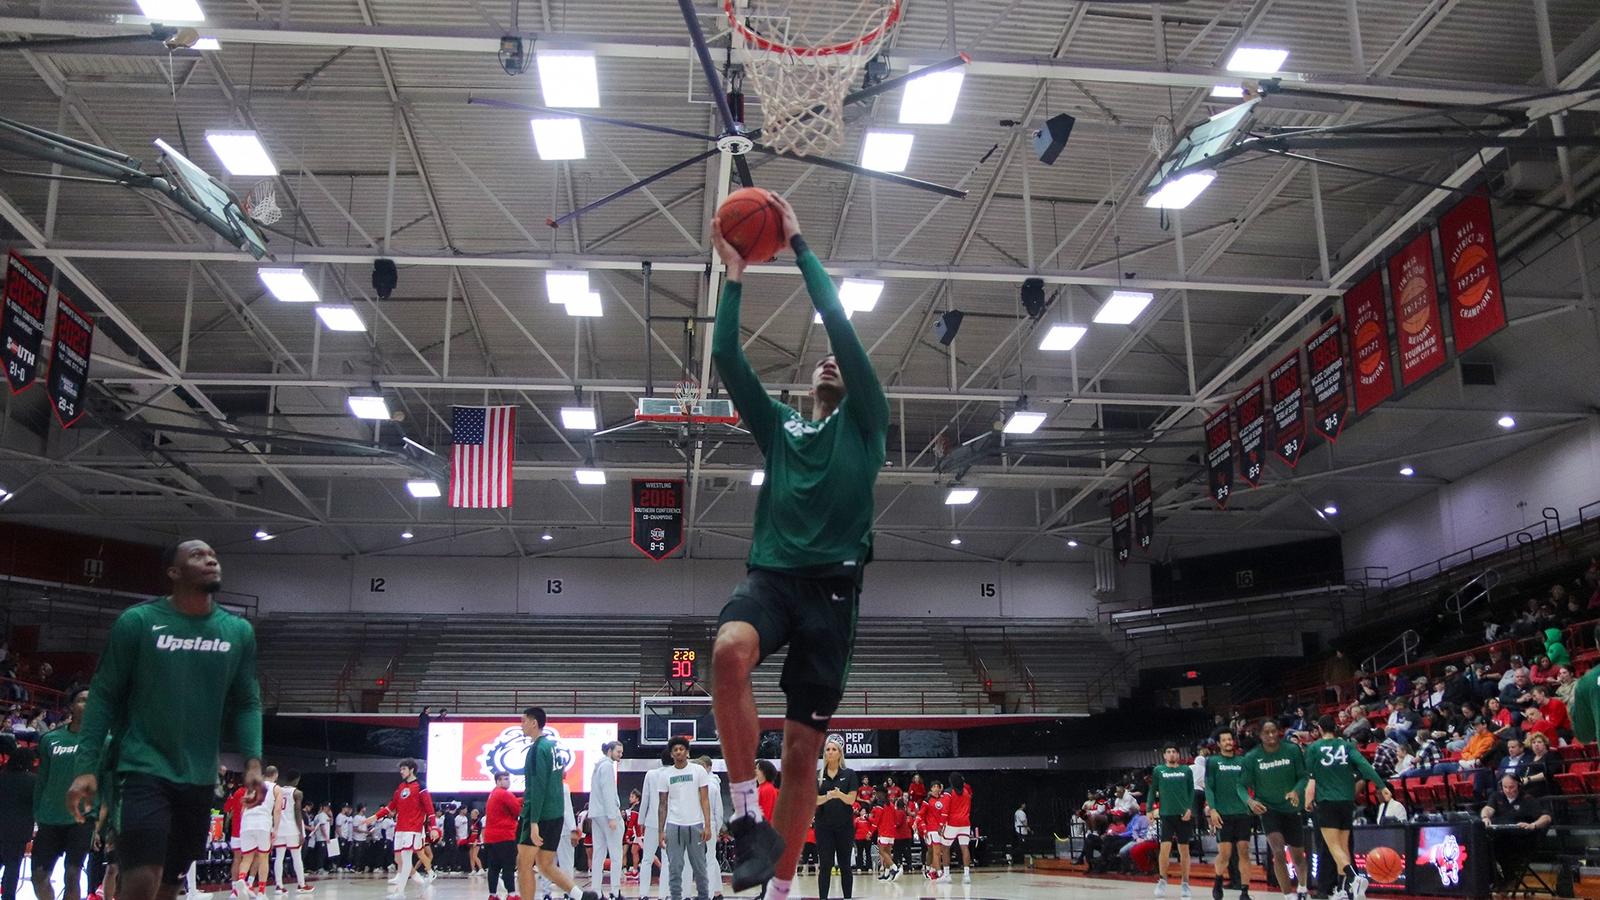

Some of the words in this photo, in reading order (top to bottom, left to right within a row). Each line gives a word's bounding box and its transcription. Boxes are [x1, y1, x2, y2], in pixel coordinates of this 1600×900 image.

[1457, 265, 1486, 290] 1973-74
[1460, 288, 1493, 318] CHAMPIONS
[1404, 334, 1436, 361] TOURNAMENT
[58, 396, 74, 416] 29-5
[640, 489, 677, 507] 2016
[371, 578, 385, 592] 12
[547, 580, 562, 593] 13
[981, 583, 996, 597] 15
[157, 635, 231, 652] Upstate
[673, 651, 695, 661] 2:28
[672, 661, 691, 677] 30
[846, 733, 864, 743] PEP
[846, 744, 873, 754] BAND
[1320, 745, 1348, 767] 34
[1259, 758, 1290, 770] Upstate
